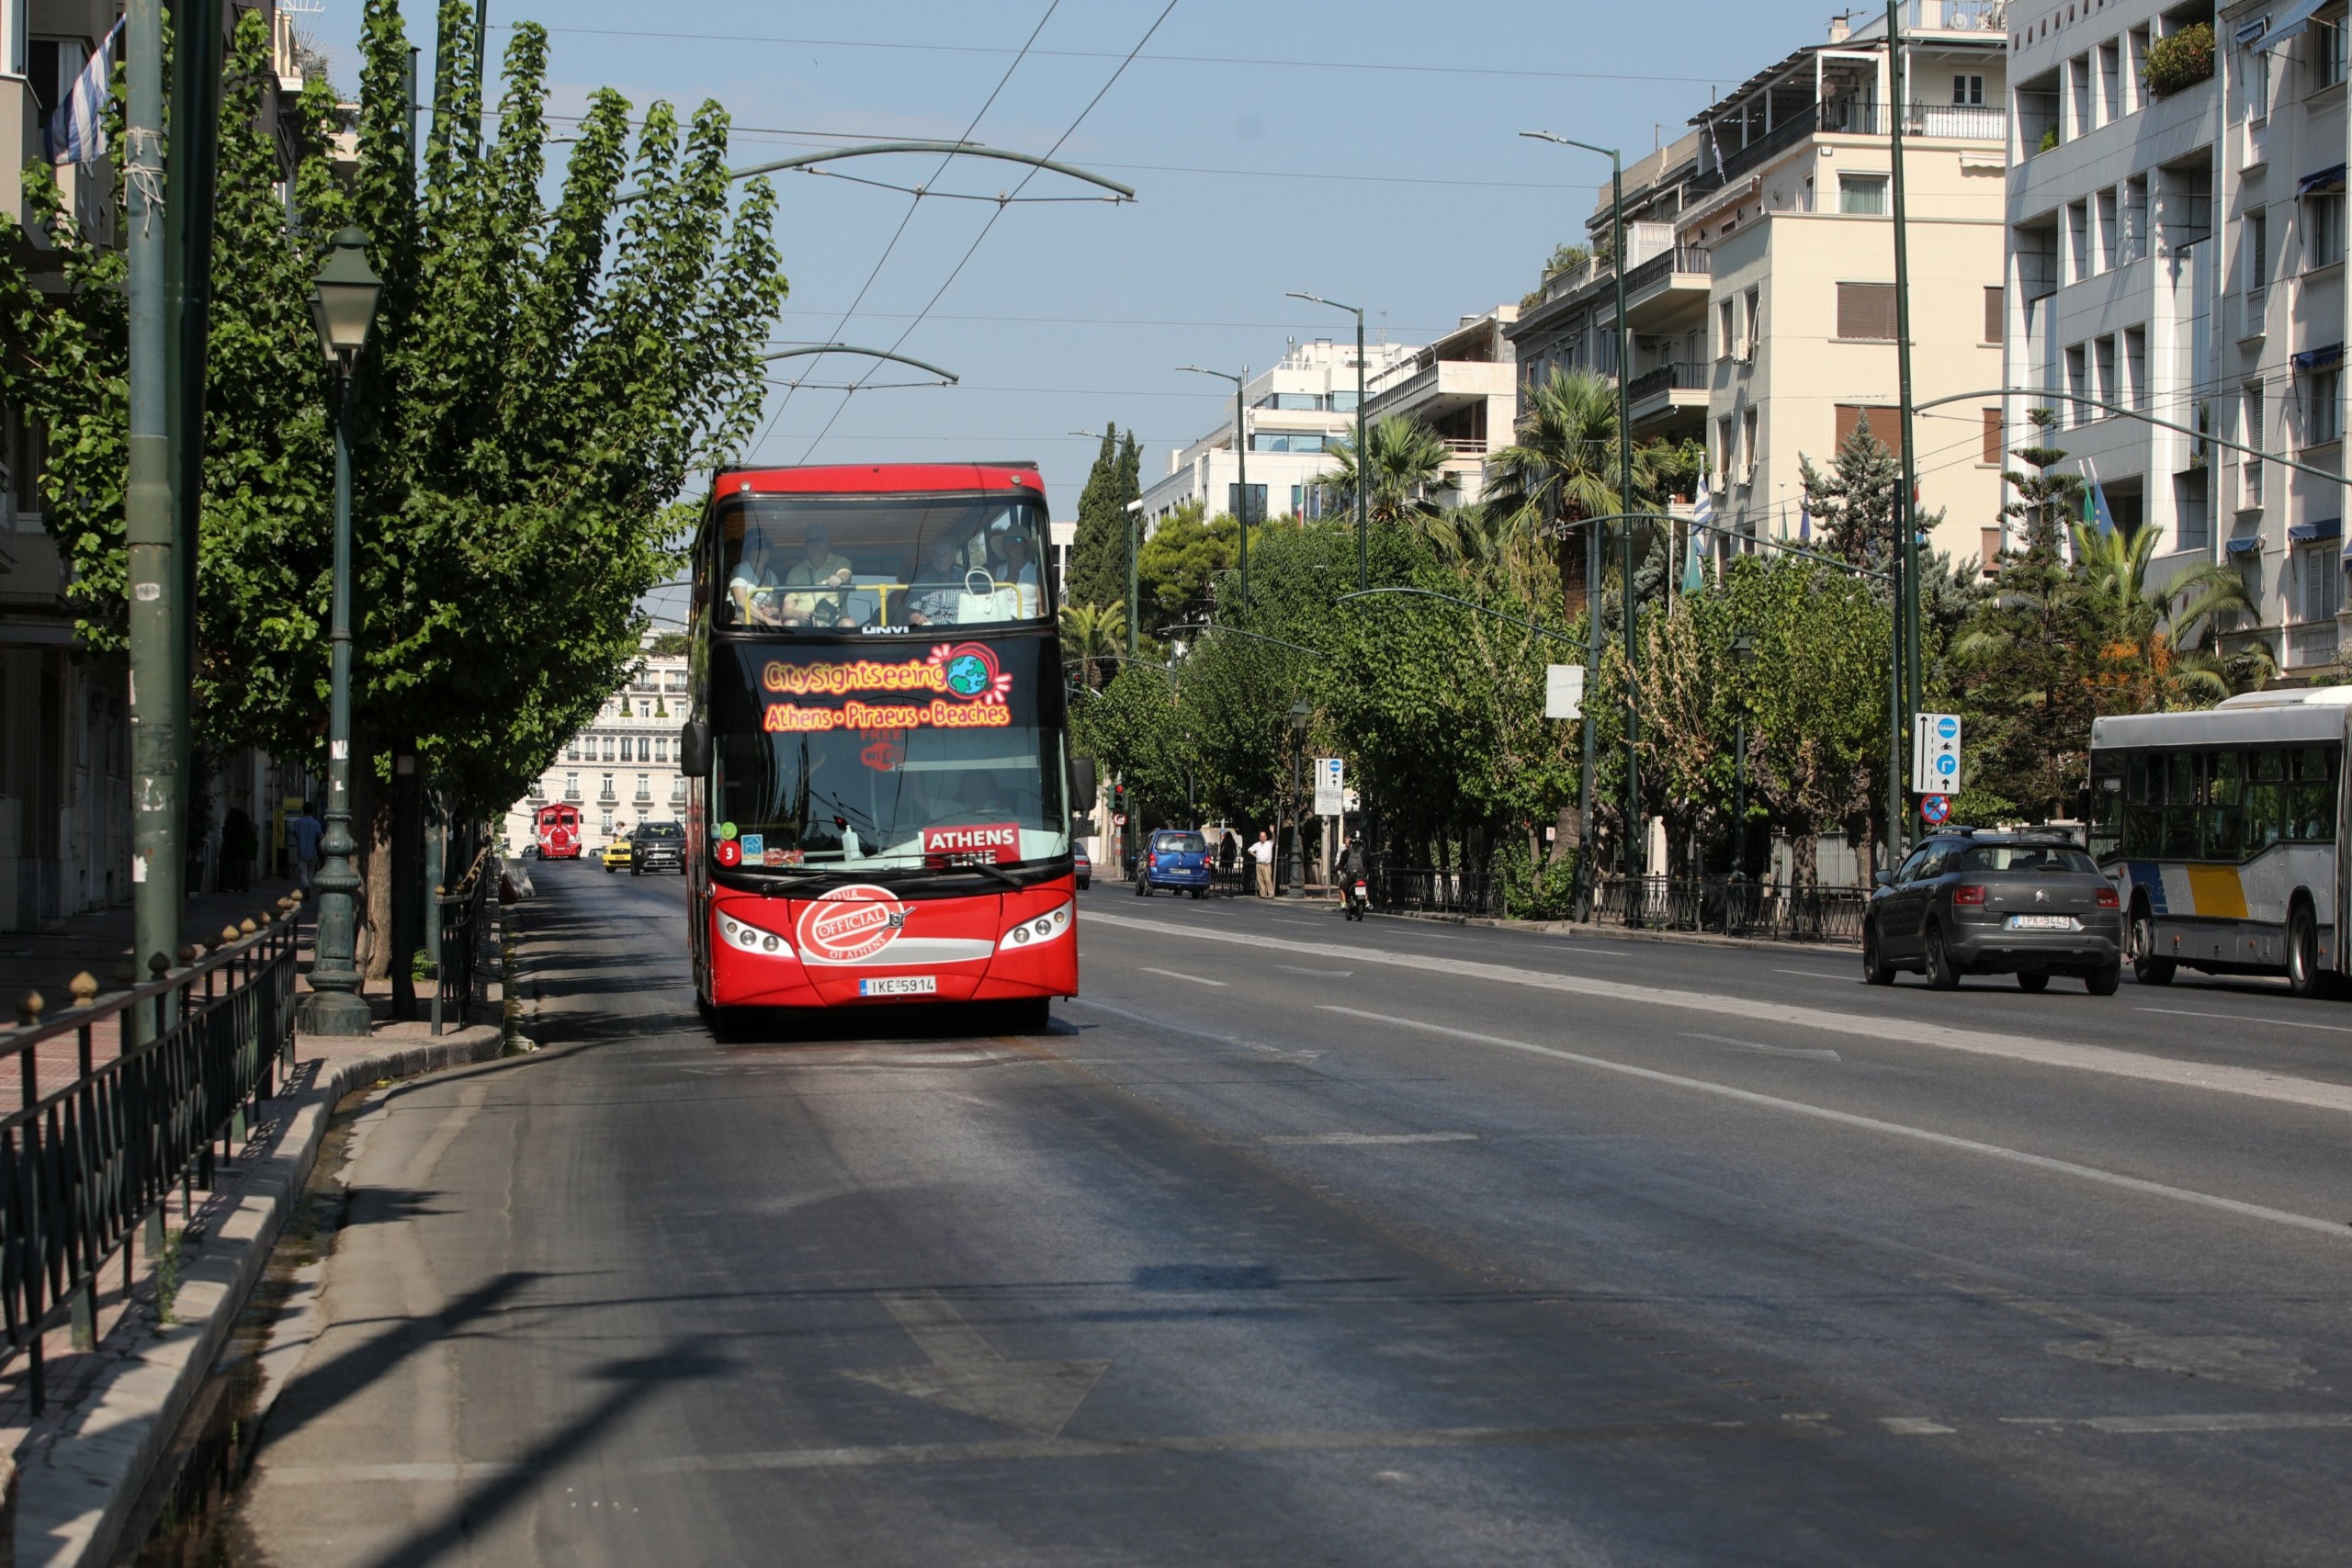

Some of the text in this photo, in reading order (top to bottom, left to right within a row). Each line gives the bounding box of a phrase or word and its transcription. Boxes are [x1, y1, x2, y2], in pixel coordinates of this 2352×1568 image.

[862, 626, 910, 635] UNVI
[764, 660, 947, 695] CitySightseeing
[765, 699, 1010, 731] Athens Piraeus Beaches
[860, 729, 902, 740] FREE
[929, 829, 1015, 850] ATHENS
[725, 847, 733, 860] 3
[950, 849, 997, 867] LINE
[818, 909, 884, 937] OFFICIAL
[829, 936, 887, 959] OF ATHENS
[873, 978, 933, 993] IKE-5914
